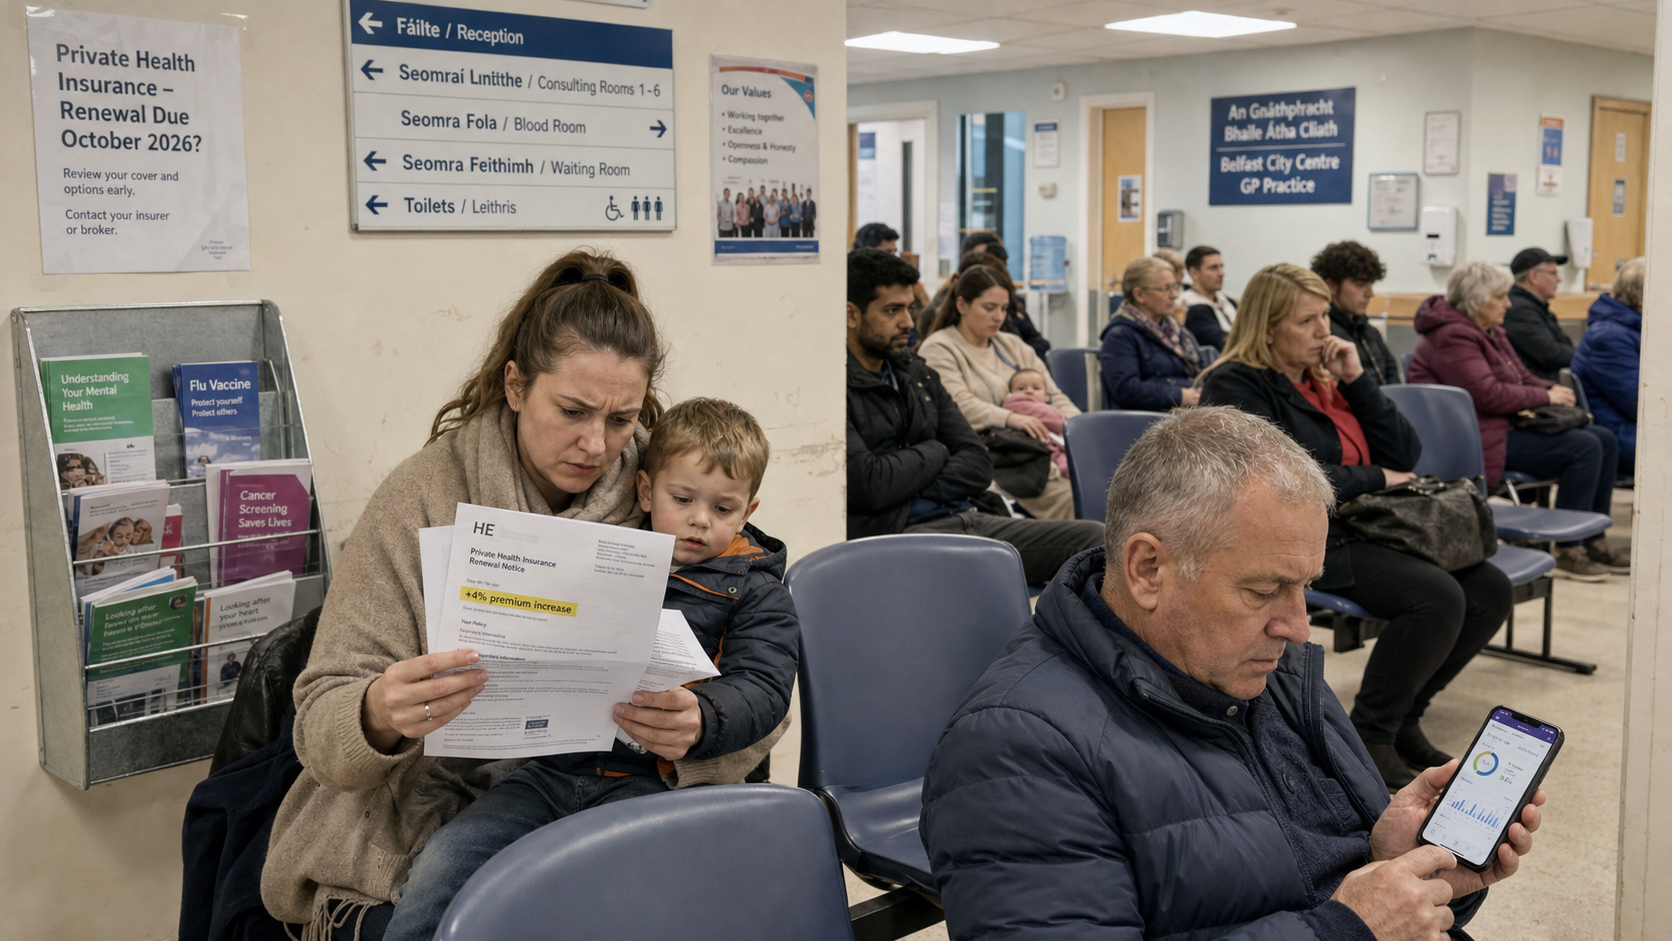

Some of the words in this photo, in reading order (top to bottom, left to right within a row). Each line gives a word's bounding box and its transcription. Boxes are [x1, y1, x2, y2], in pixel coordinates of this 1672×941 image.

[396, 18, 440, 39] Fáilte
[446, 23, 452, 38] /
[457, 24, 524, 46] Reception
[56, 43, 130, 67] Private
[136, 50, 196, 72] Health
[58, 72, 158, 96] Insurance
[399, 64, 464, 84] Seomraí
[528, 74, 533, 89] /
[537, 75, 596, 96] Consulting
[600, 80, 635, 95] Rooms
[722, 84, 739, 95] Our
[742, 85, 772, 98] Values
[60, 101, 146, 124] Renewal
[153, 106, 189, 125] Due
[1228, 104, 1247, 121] An
[401, 110, 461, 129] Seomra
[466, 113, 497, 131] Fola
[502, 117, 508, 131] /
[514, 116, 549, 133] Blood
[553, 120, 587, 134] Room
[61, 130, 142, 150] October
[148, 134, 202, 153] 2026?
[402, 154, 464, 172] Seomra
[470, 157, 534, 174] Feithimh
[540, 161, 545, 174] /
[551, 160, 595, 179] Waiting
[599, 162, 630, 176] Room
[1220, 155, 1264, 173] Belfast
[1266, 154, 1293, 175] City
[1295, 153, 1340, 171] Centre
[63, 168, 102, 180] Review
[104, 170, 128, 182] your
[131, 172, 158, 182] cover
[161, 171, 179, 182] and
[64, 184, 104, 197] options
[107, 185, 135, 197] early.
[1240, 178, 1260, 194] GP
[1263, 176, 1316, 194] Practice
[404, 197, 455, 214] Toilets
[461, 200, 466, 213] /
[472, 200, 516, 214] Leithris
[65, 209, 107, 220] Contact
[110, 211, 133, 222] your
[136, 211, 170, 221] insurer
[66, 226, 77, 235] or
[81, 224, 118, 236] broker.
[61, 372, 129, 384] Understanding
[190, 380, 207, 391] Flu
[209, 378, 251, 391] Vaccine
[62, 388, 83, 398] Your
[86, 384, 117, 396] Mental
[63, 400, 93, 411] Health
[240, 490, 276, 501] Cancer
[239, 503, 288, 516] Screening
[238, 518, 266, 528] Saves
[268, 517, 292, 527] Lives
[473, 521, 495, 536] HE
[469, 557, 500, 569] Renewal
[502, 564, 525, 573] Notice
[470, 547, 495, 559] Private
[497, 552, 520, 563] Health
[522, 556, 557, 568] Insurance
[465, 591, 487, 601] +4%
[489, 595, 531, 609] premium
[534, 601, 572, 614] increase
